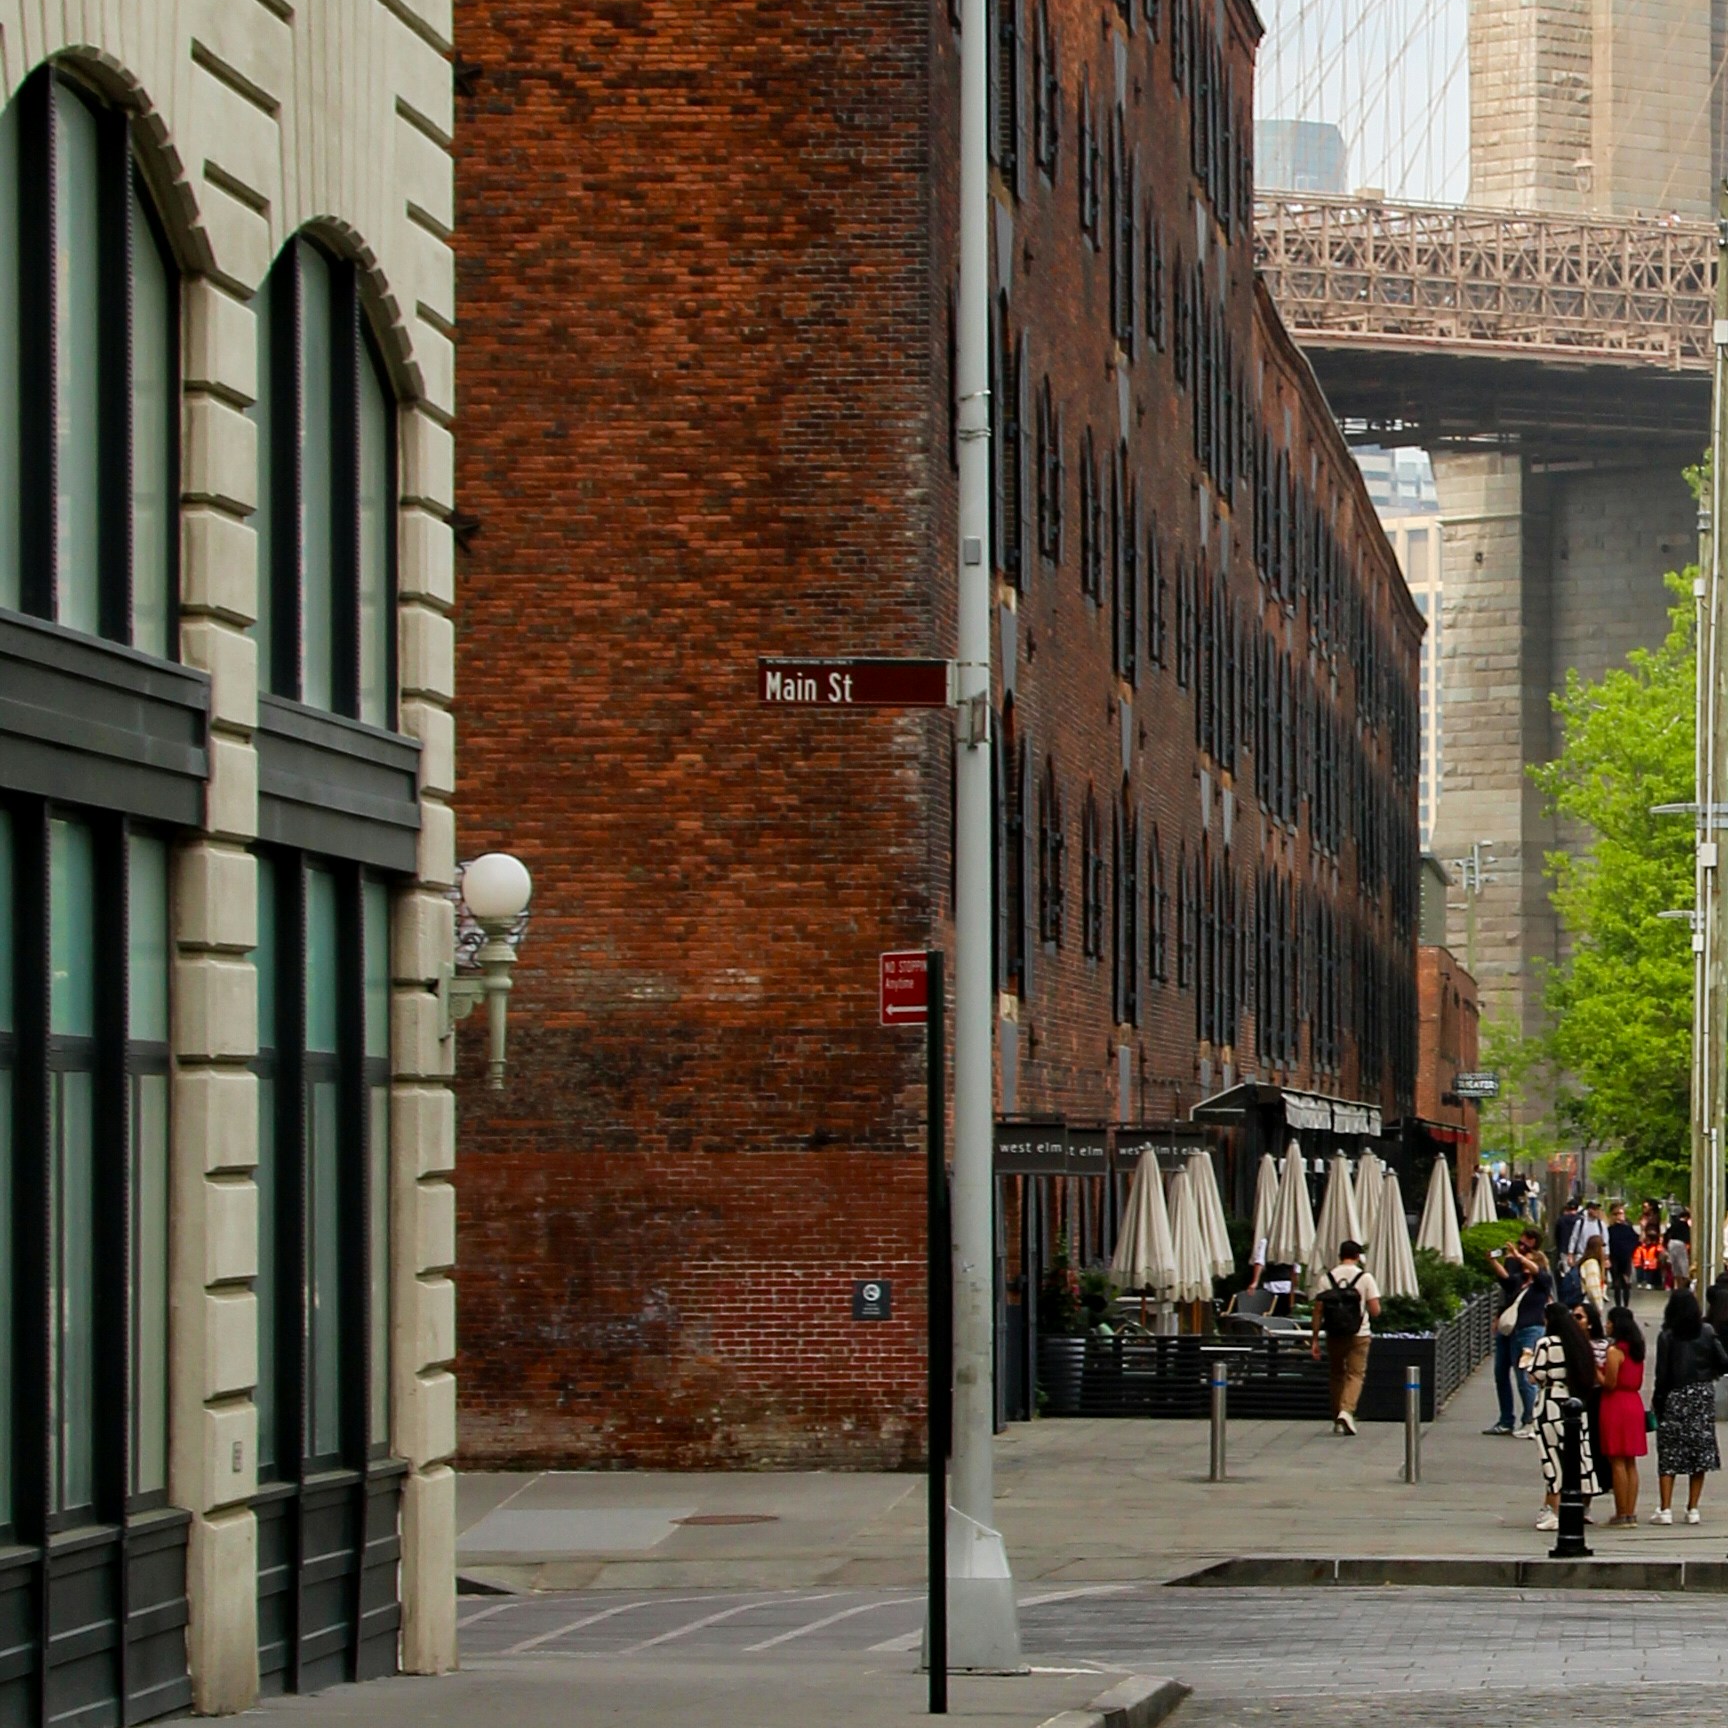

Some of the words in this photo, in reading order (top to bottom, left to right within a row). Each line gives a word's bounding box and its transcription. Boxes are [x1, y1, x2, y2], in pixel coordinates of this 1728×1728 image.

[766, 671, 817, 701] Main
[828, 672, 854, 703] St
[885, 960, 896, 973] NO
[898, 960, 927, 973] STOPPIN
[885, 978, 914, 992] Anytime
[999, 1142, 1032, 1153] west
[1036, 1142, 1063, 1153] elm
[1078, 1146, 1104, 1156] elm
[1118, 1146, 1140, 1155] wes
